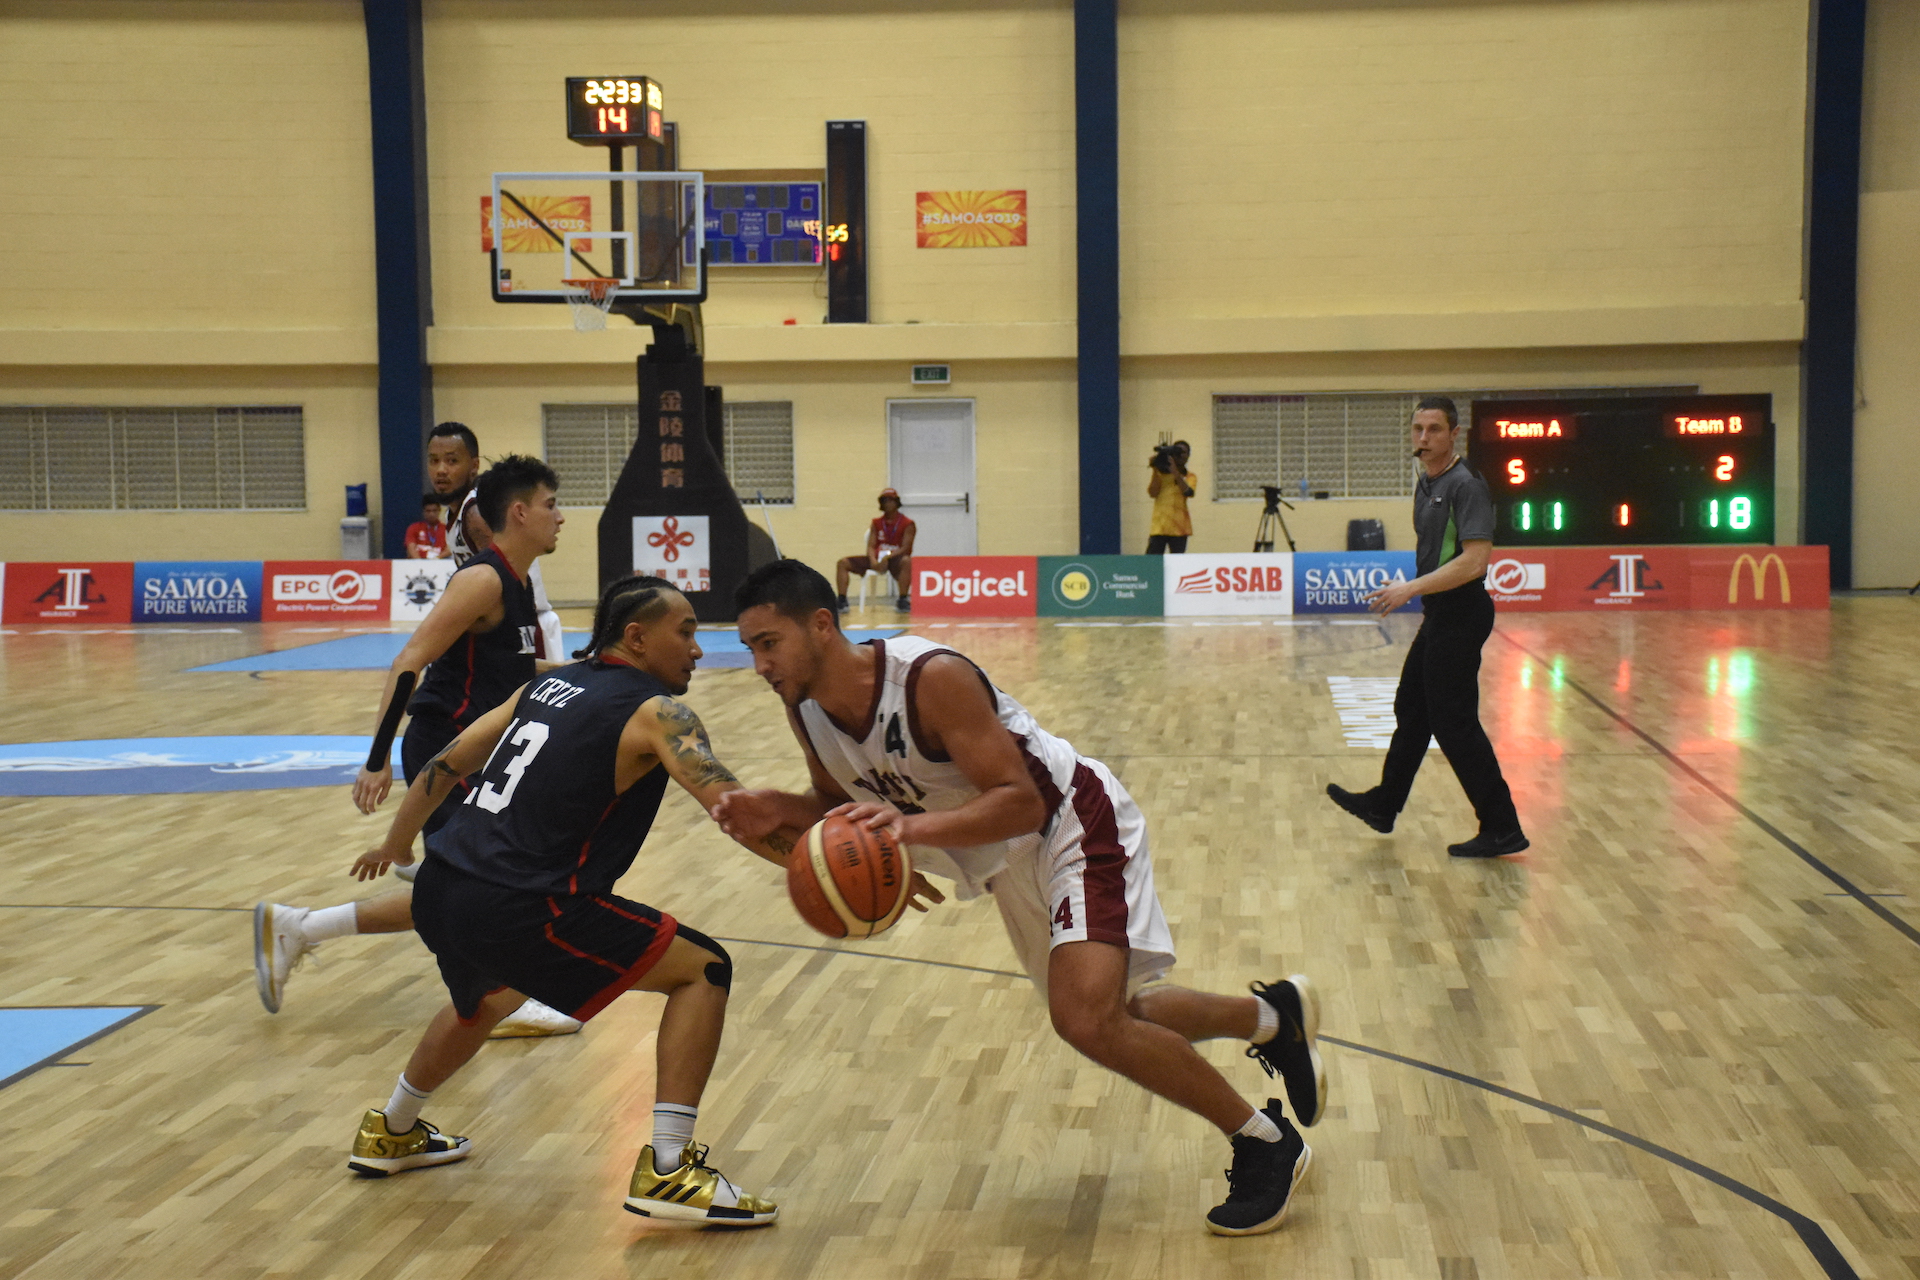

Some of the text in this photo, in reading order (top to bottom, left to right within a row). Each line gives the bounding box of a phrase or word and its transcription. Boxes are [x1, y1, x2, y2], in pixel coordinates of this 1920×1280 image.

[598, 107, 627, 133] 14
[922, 211, 1021, 225] #SAMOA2019
[1496, 419, 1562, 438] Team A
[1675, 415, 1743, 434] Team B
[1507, 458, 1526, 484] 5
[1715, 455, 1735, 481] 2
[1619, 503, 1629, 526] 1
[1710, 497, 1751, 529] 18
[144, 577, 248, 599] SAMOA
[281, 580, 320, 593] EPC
[919, 570, 1028, 604] Digicel
[1064, 581, 1087, 590] SCB
[1215, 566, 1282, 592] SSAB
[1305, 568, 1408, 590] SAMOA
[144, 600, 248, 614] PURE WATER
[1305, 591, 1349, 605] PURE
[530, 677, 585, 709] CRUZ
[1049, 895, 1073, 938] 4
